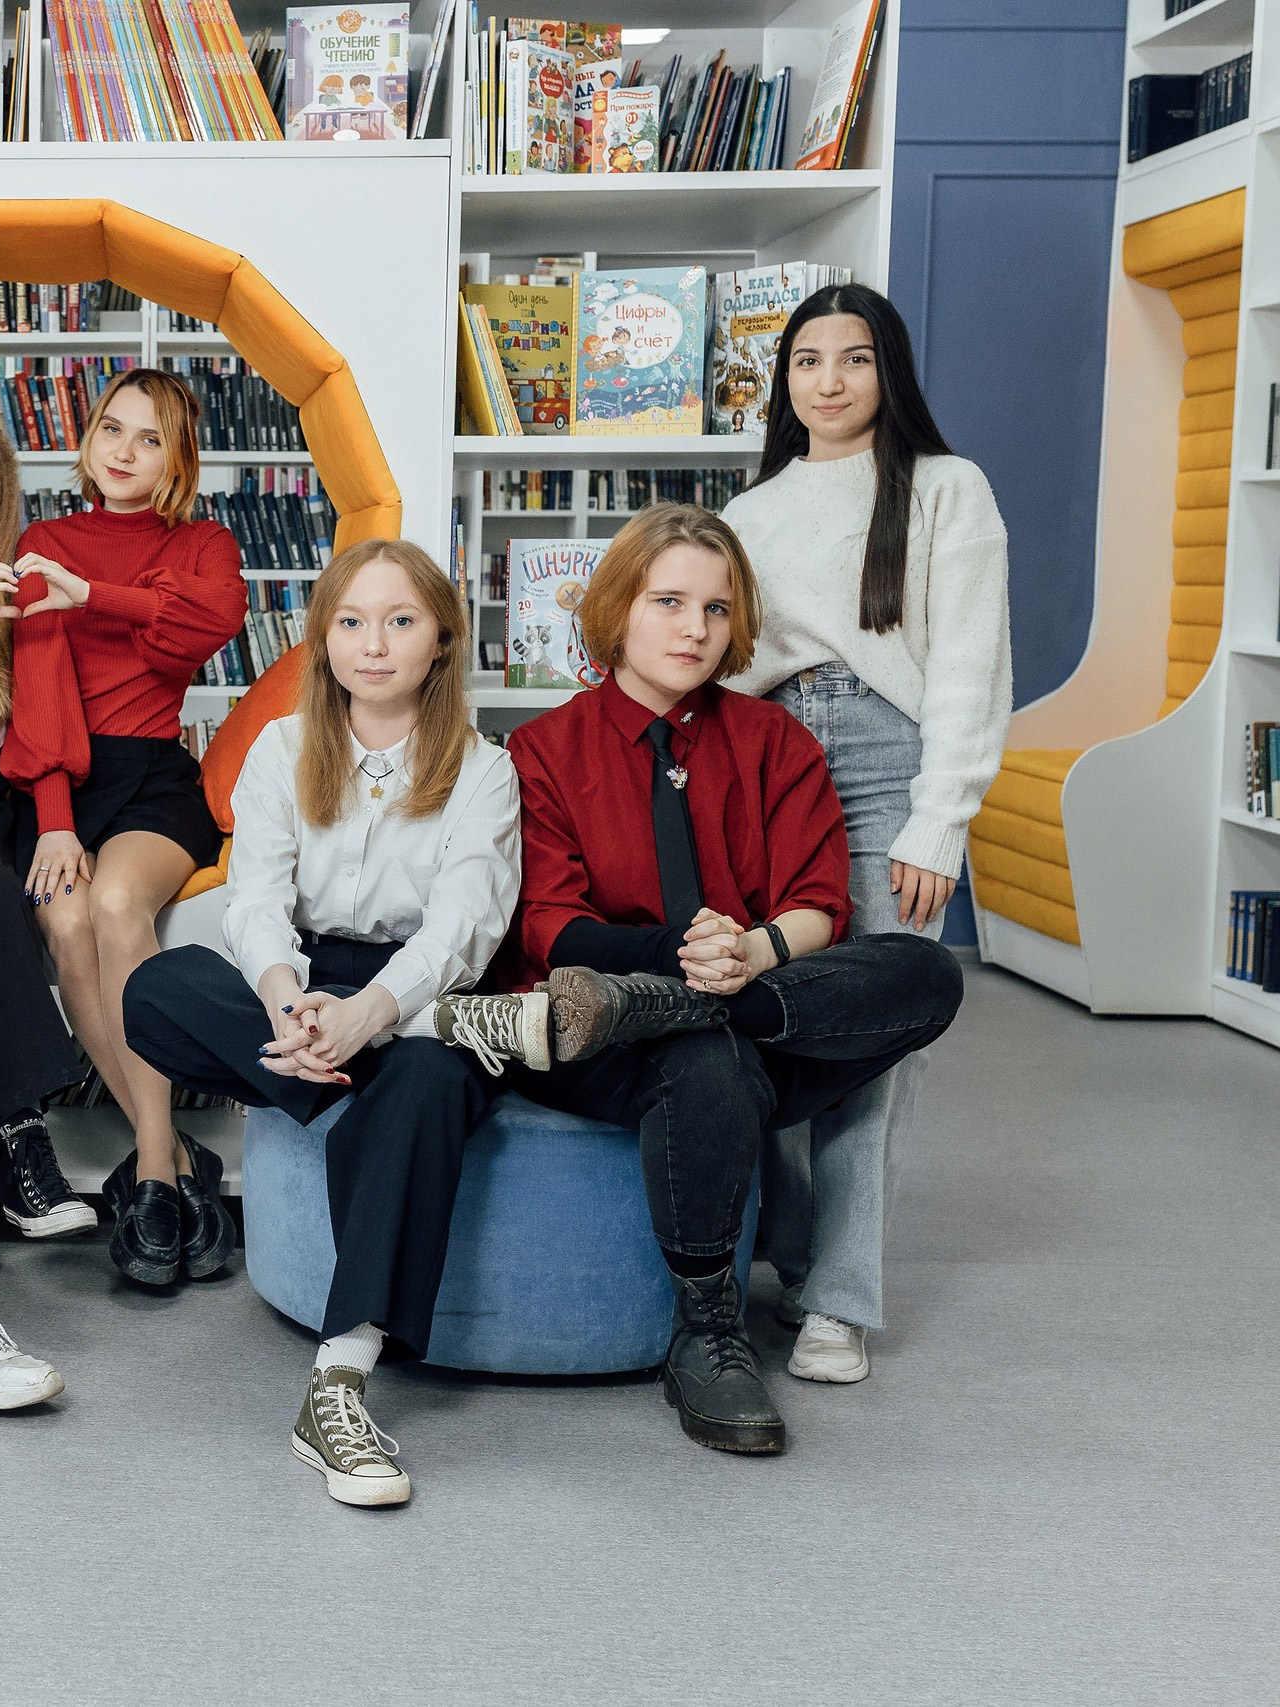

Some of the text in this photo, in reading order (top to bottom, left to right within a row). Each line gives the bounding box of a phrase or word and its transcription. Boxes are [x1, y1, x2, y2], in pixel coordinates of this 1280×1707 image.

[320, 36, 380, 49] ОБУЧЕНИЕ
[325, 49, 374, 62] ЧТЕНИЮ
[610, 104, 624, 112] При
[627, 113, 637, 122] 01
[749, 276, 774, 289] КАК
[509, 291, 549, 308] Один день
[724, 287, 800, 312] ОДЕВАЛСЯ
[616, 304, 666, 322] Цифры
[738, 314, 781, 325] ПЕРВОБЫТНЫЙ
[489, 318, 569, 336] ПОЖАРНОЙ
[496, 336, 560, 351] СТАНЦИИ
[634, 333, 672, 348] счёт
[560, 543, 606, 552] ЗАВЯЗЫВА
[522, 551, 597, 583] ШНУРК
[518, 600, 531, 610] 20
